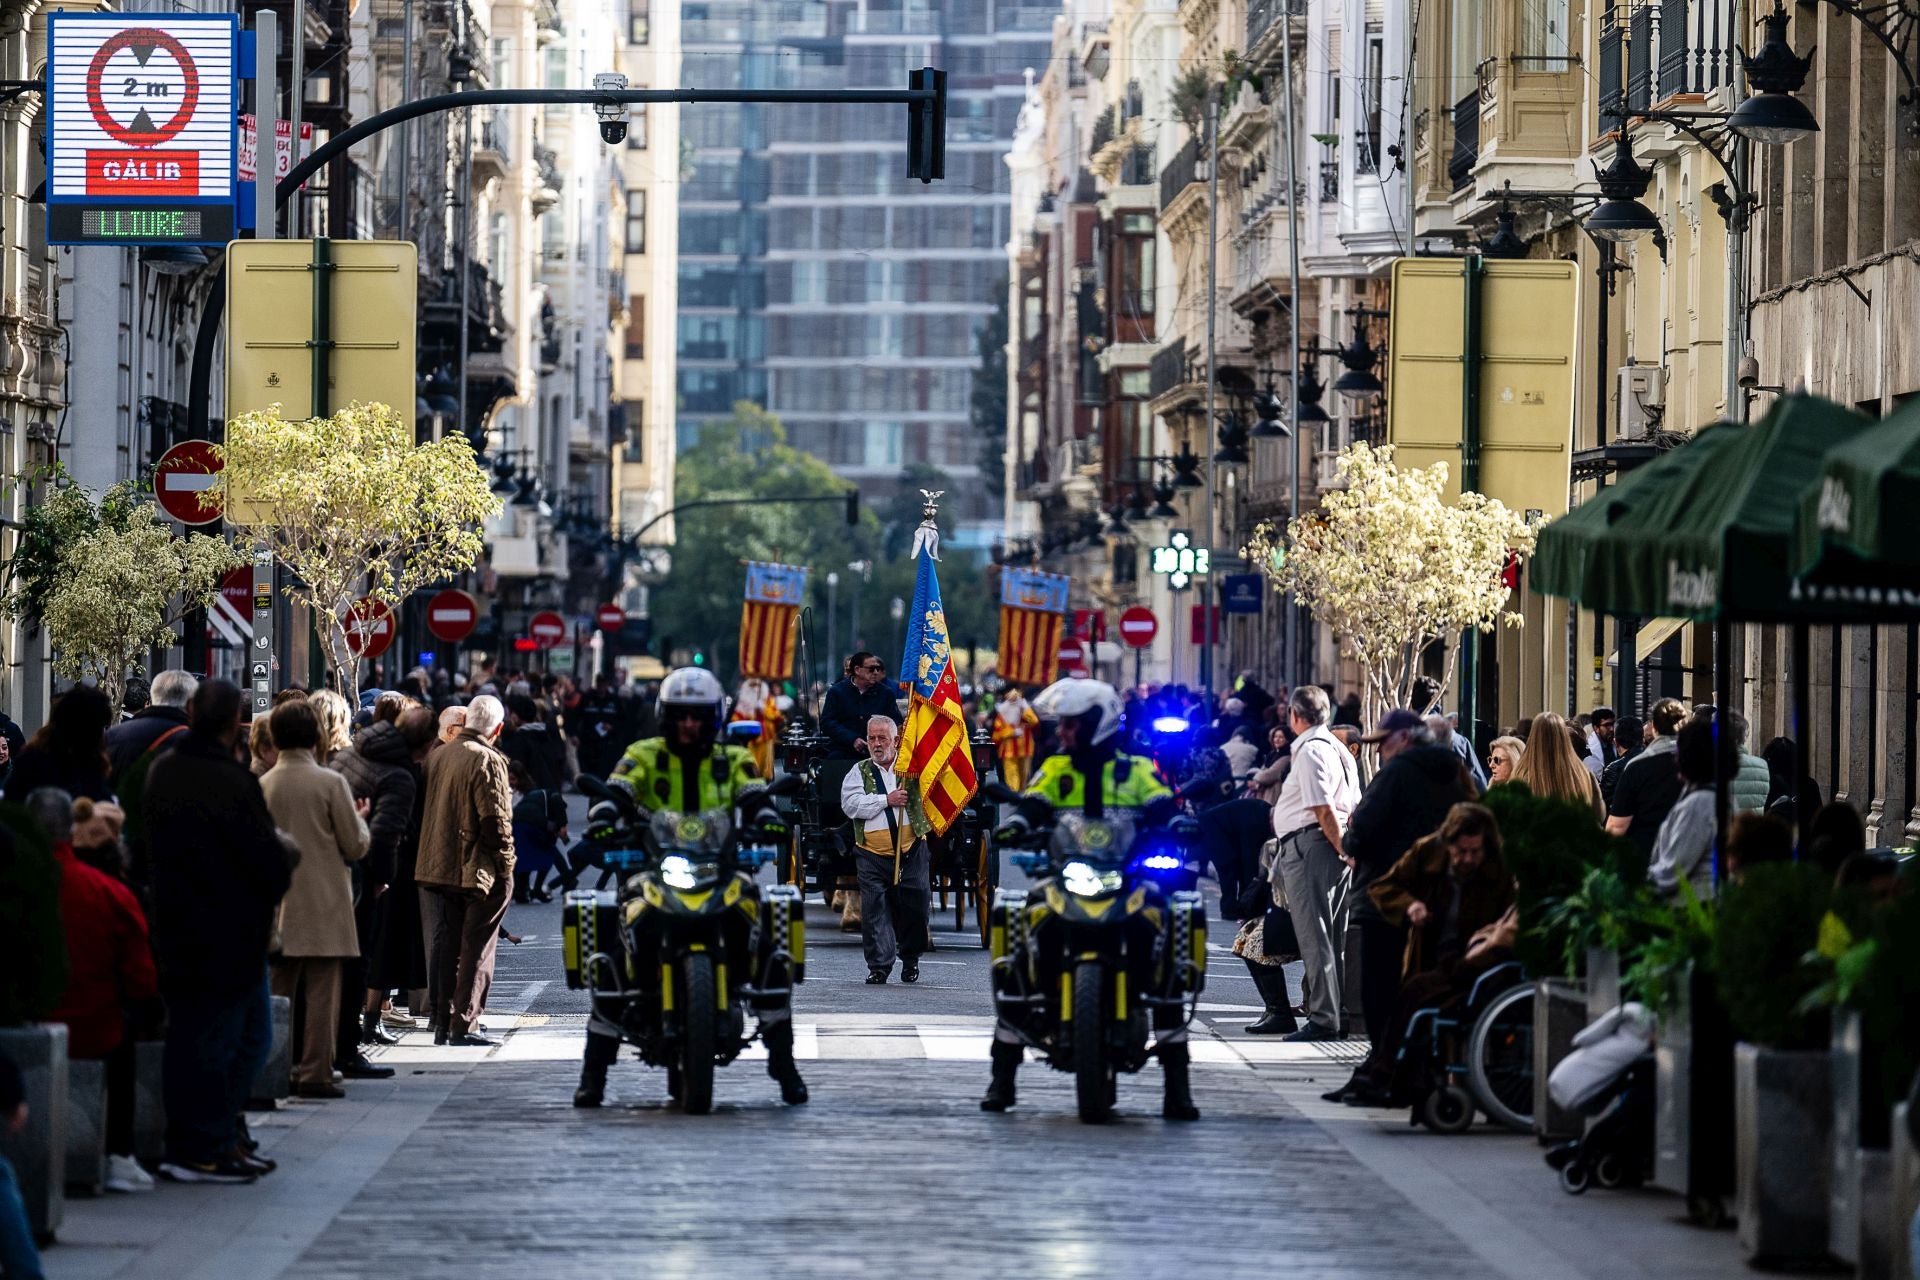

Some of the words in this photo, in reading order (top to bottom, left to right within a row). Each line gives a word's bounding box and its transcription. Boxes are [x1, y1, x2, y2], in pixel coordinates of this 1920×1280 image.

[123, 77, 139, 97] 2
[146, 82, 168, 97] m
[100, 211, 184, 236] LLIURE
